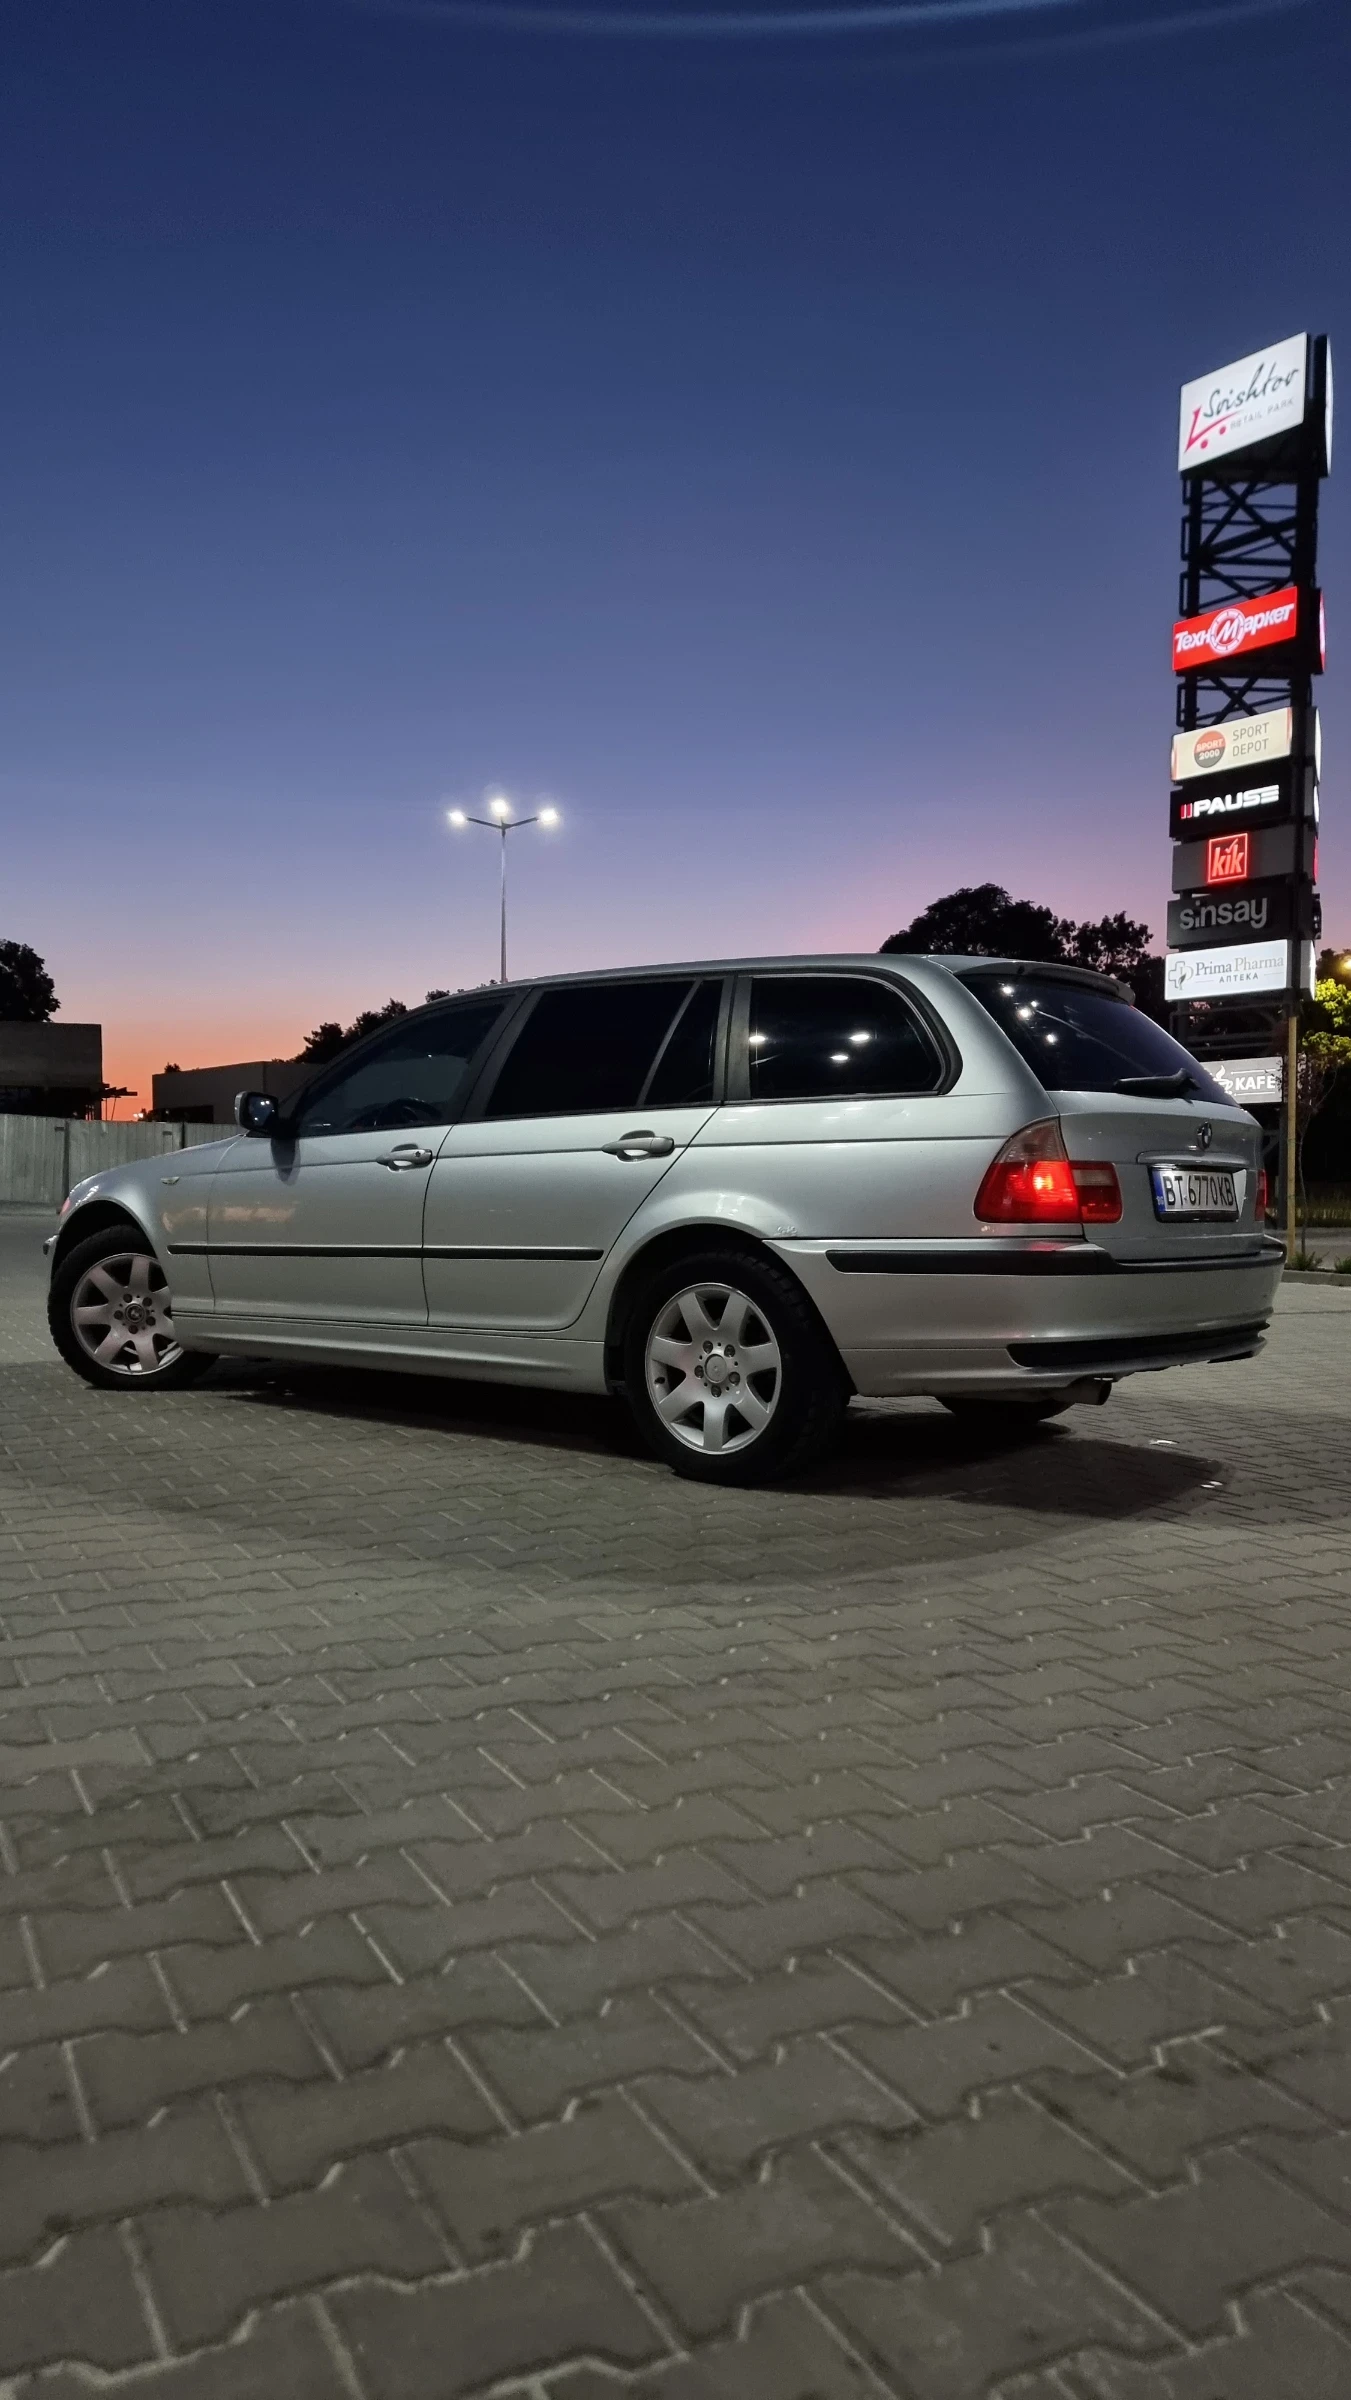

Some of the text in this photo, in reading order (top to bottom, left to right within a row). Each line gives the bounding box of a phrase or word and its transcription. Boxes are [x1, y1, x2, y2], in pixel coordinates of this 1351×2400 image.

[1230, 397, 1295, 430] RETAIL PARK
[1232, 721, 1270, 742] SPORT
[1195, 738, 1224, 752] SPORT
[1198, 748, 1221, 761] 2000
[1232, 738, 1270, 757] DEPOT
[1193, 784, 1280, 818] PAUSE
[1179, 898, 1268, 930] sinsay
[1195, 956, 1284, 977] Prima Pharma
[1219, 972, 1259, 984] АПТЕКА
[1235, 1075, 1276, 1091] KAFE
